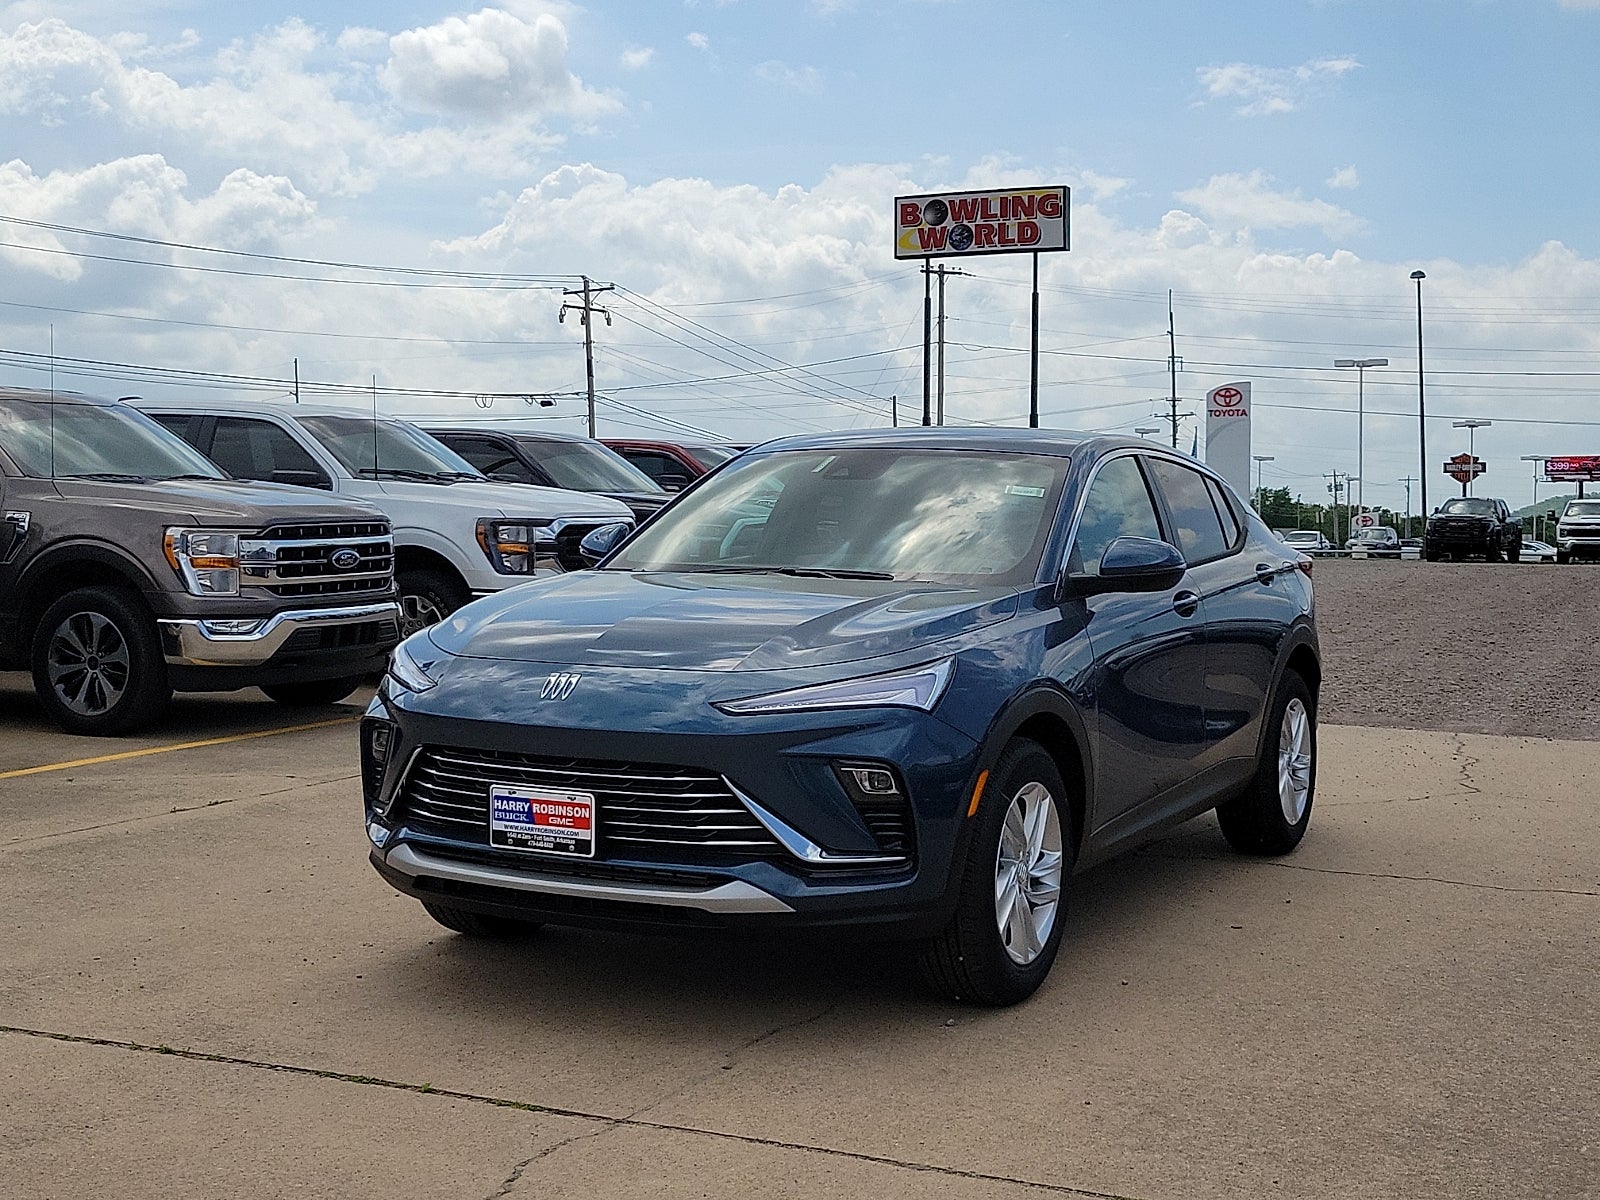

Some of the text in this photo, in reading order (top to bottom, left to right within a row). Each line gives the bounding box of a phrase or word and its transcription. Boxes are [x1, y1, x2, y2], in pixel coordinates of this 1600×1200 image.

[900, 193, 1061, 227] BOWLING
[917, 221, 1041, 251] WORLD
[1207, 408, 1248, 418] TOYOTA
[1546, 461, 1570, 471] $399
[494, 799, 590, 819] HARRY ROBINSON
[494, 811, 575, 826] BUICK GMC
[503, 824, 580, 837] WWW.HARRYROBINSON.COM
